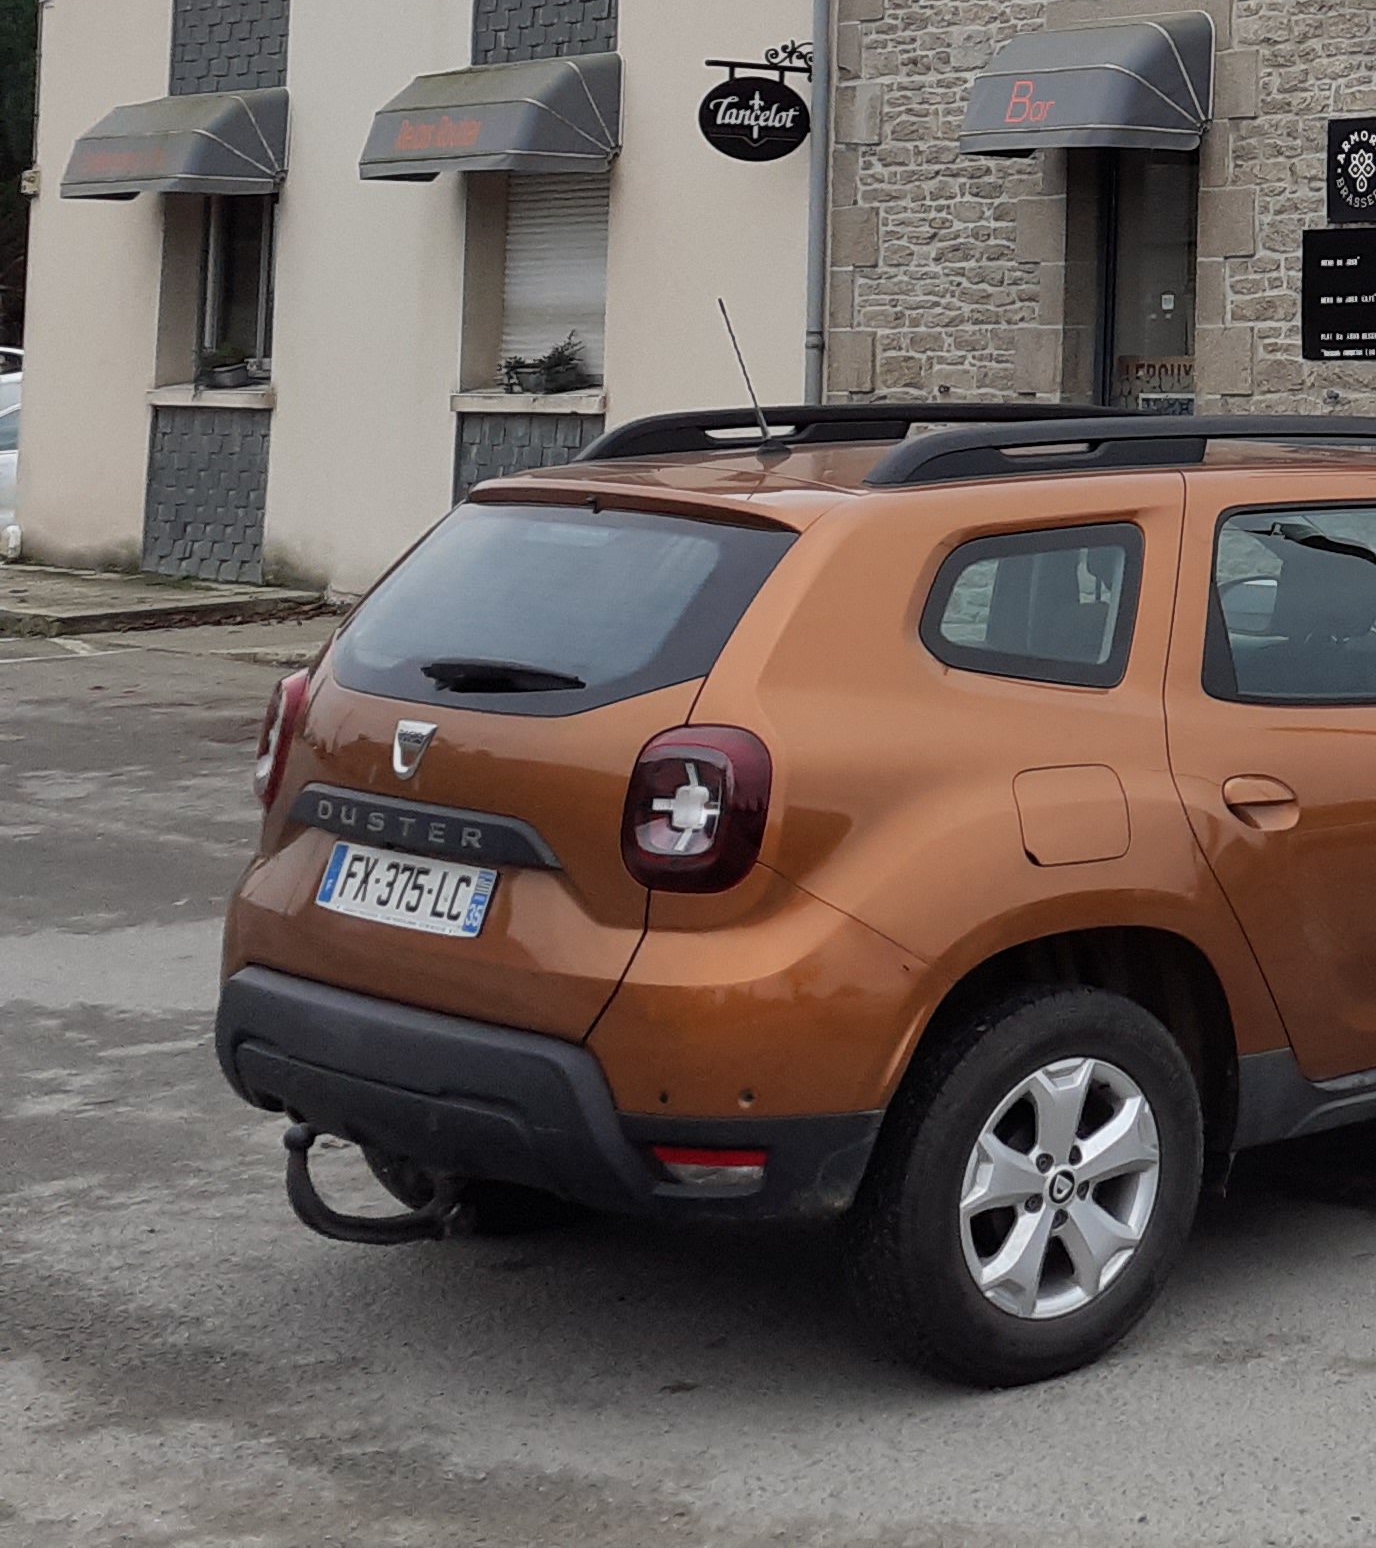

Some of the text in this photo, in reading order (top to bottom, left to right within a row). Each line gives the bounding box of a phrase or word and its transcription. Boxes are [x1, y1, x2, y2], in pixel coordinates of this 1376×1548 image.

[709, 95, 800, 128] Lancelot
[1005, 81, 1055, 123] Bar
[317, 799, 482, 849] DUSTER
[466, 903, 484, 927] 35
